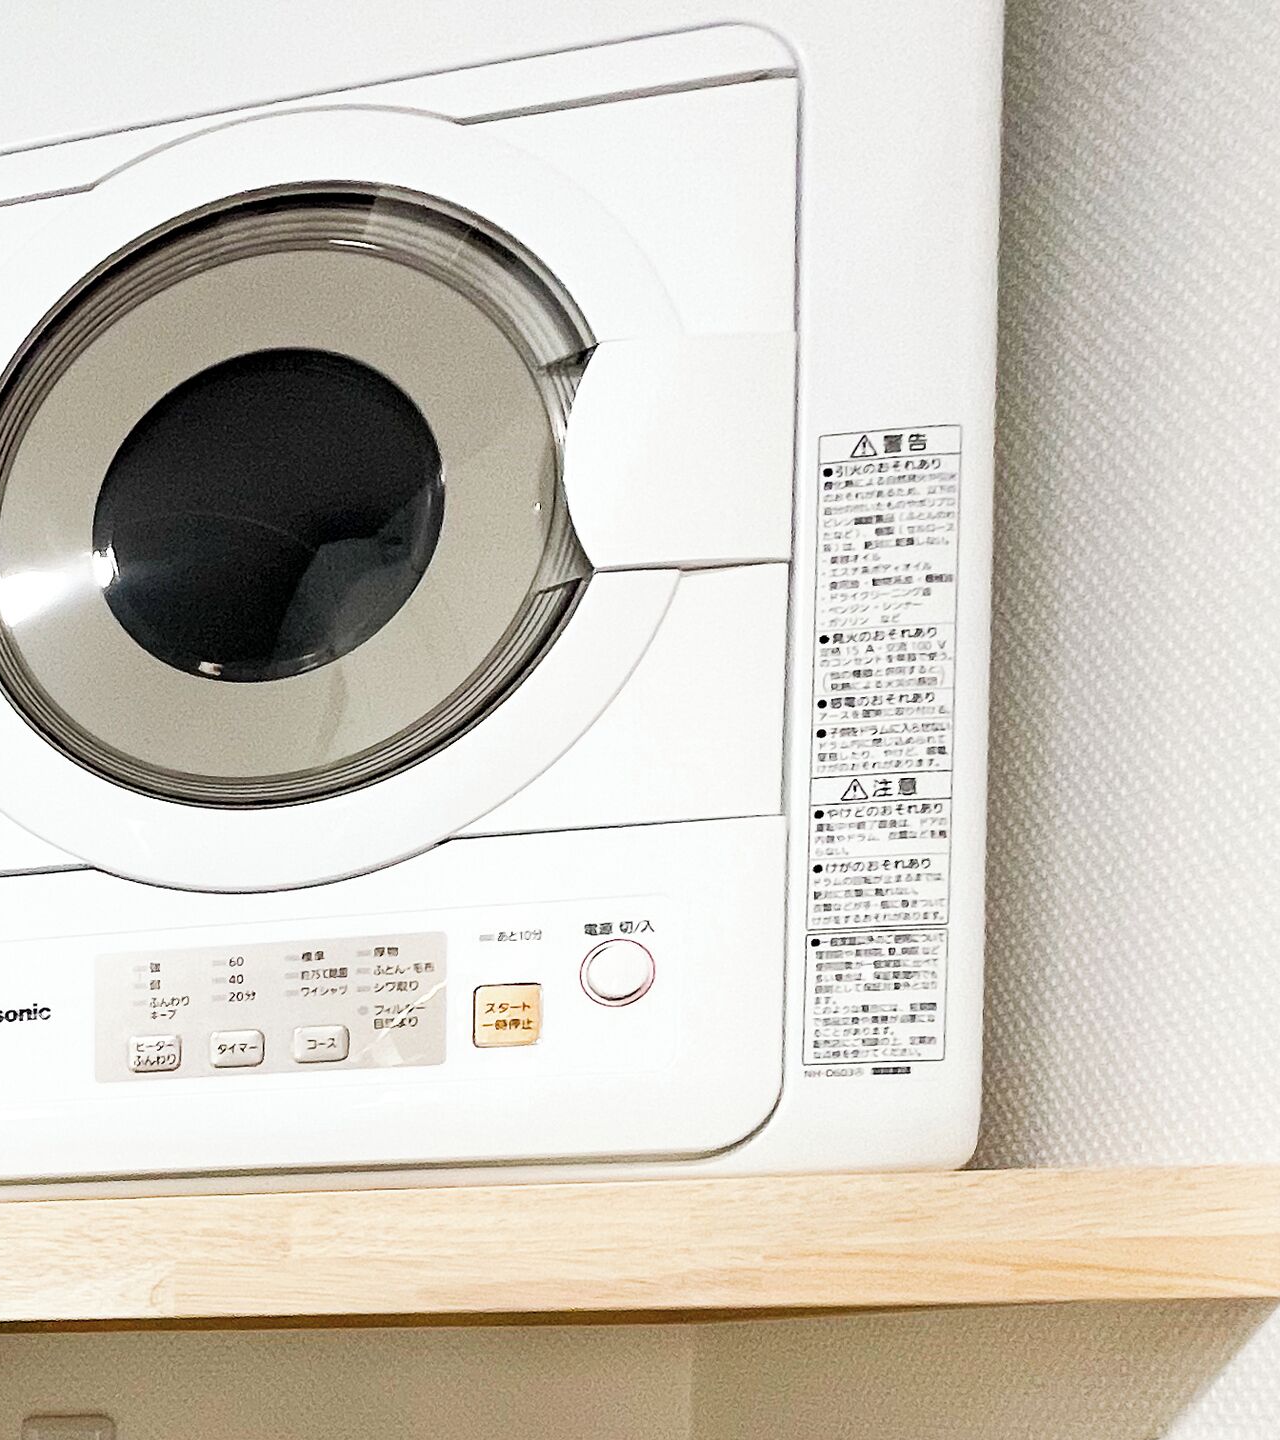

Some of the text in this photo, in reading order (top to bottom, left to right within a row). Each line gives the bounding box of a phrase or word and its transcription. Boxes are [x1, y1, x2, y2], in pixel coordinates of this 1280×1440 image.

[872, 777, 918, 798] 注意
[827, 803, 944, 820] やけどのおそれあり
[825, 857, 932, 874] けがのおそれあり
[497, 929, 543, 942] あと10分
[228, 956, 245, 967] 60
[228, 974, 245, 985] 40
[228, 991, 257, 1002] 20分
[301, 985, 349, 997] ワイシャツ
[149, 995, 190, 1008] ふんわり
[484, 1001, 531, 1014] スタート
[136, 1040, 175, 1053] ヒーター
[217, 1043, 258, 1055] タイマー
[306, 1038, 337, 1050] コース
[133, 1053, 177, 1066] ふんわり
